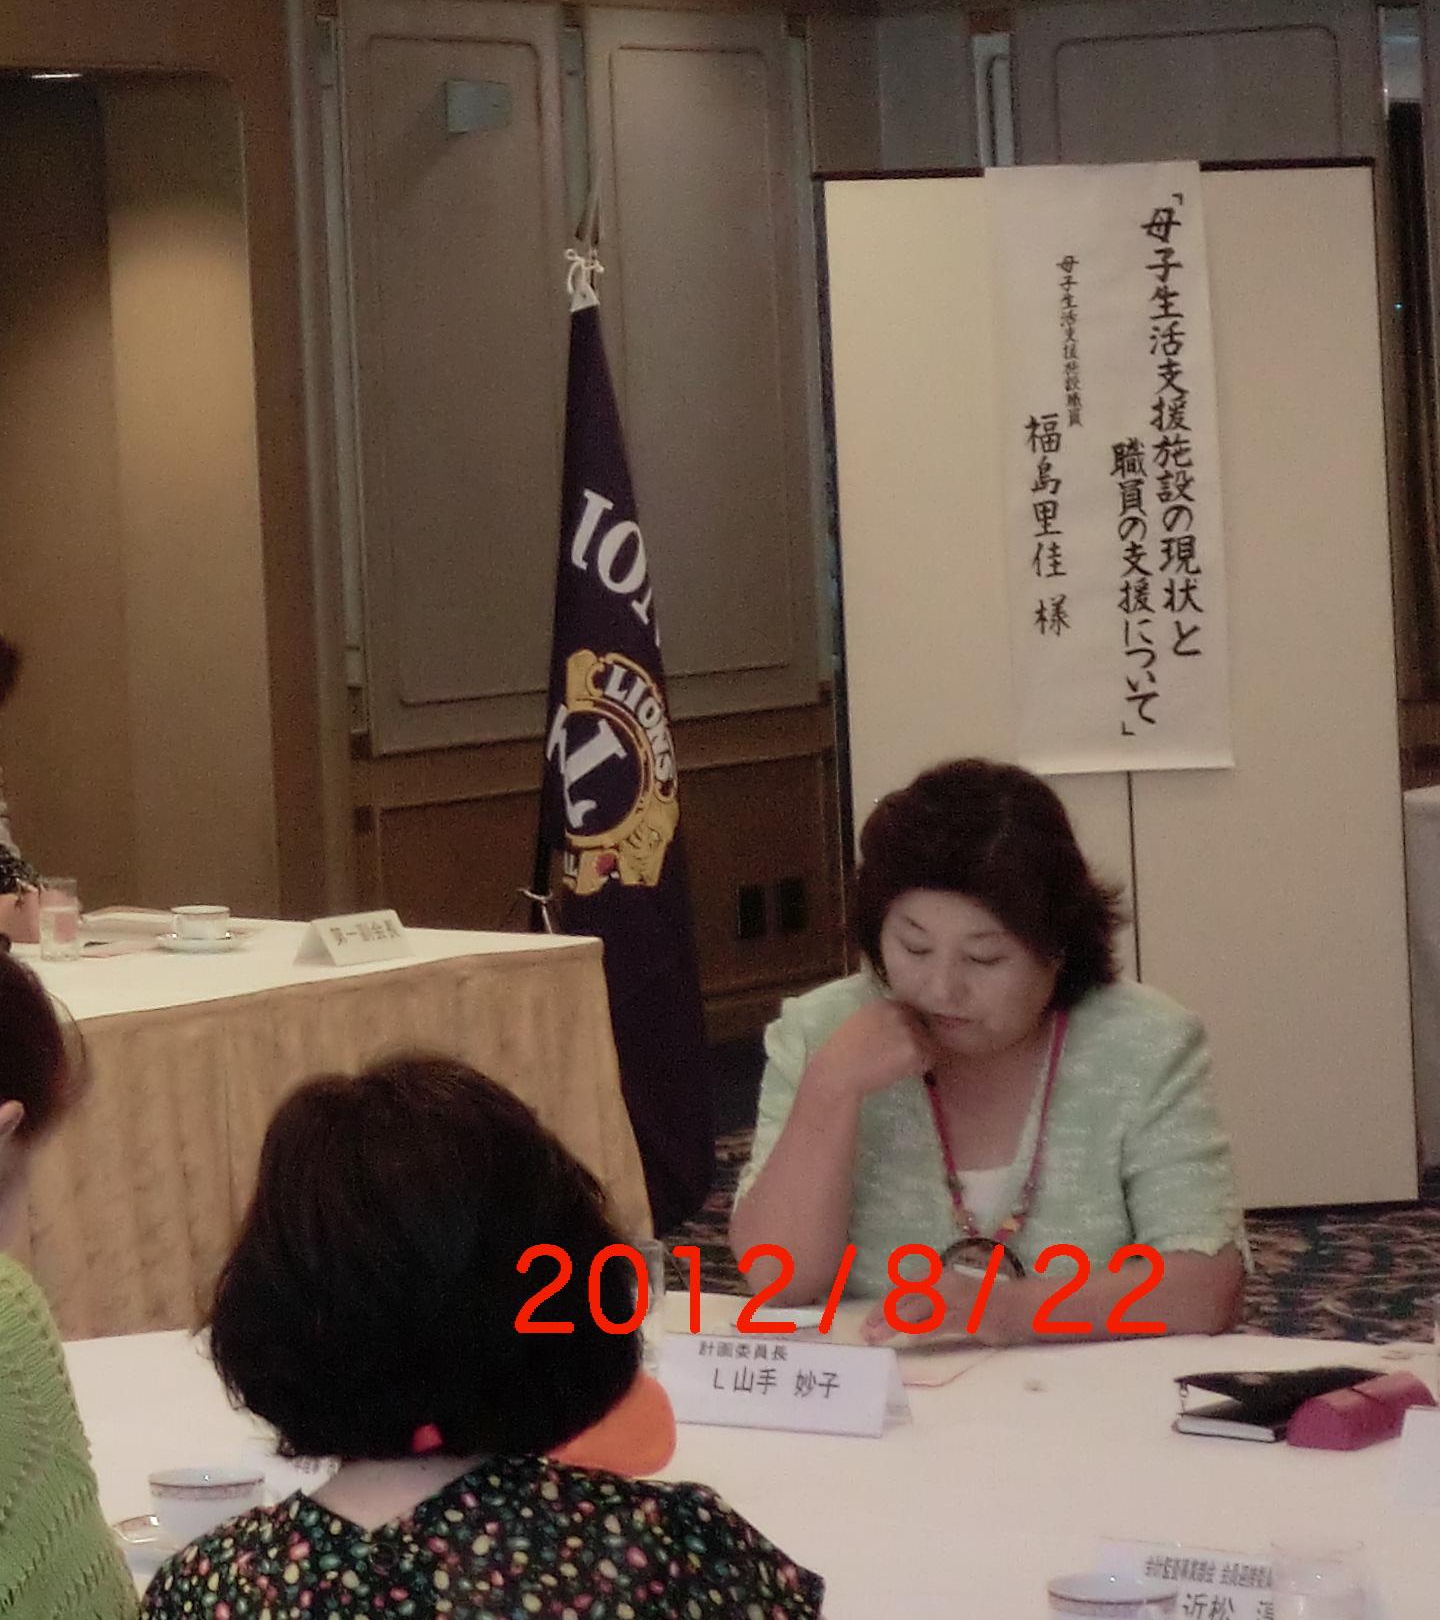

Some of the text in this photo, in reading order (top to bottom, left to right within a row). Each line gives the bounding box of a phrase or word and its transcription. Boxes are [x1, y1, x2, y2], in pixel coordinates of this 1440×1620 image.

[1110, 436, 1160, 737] 職員の支援について」
[604, 663, 672, 782] LIONS
